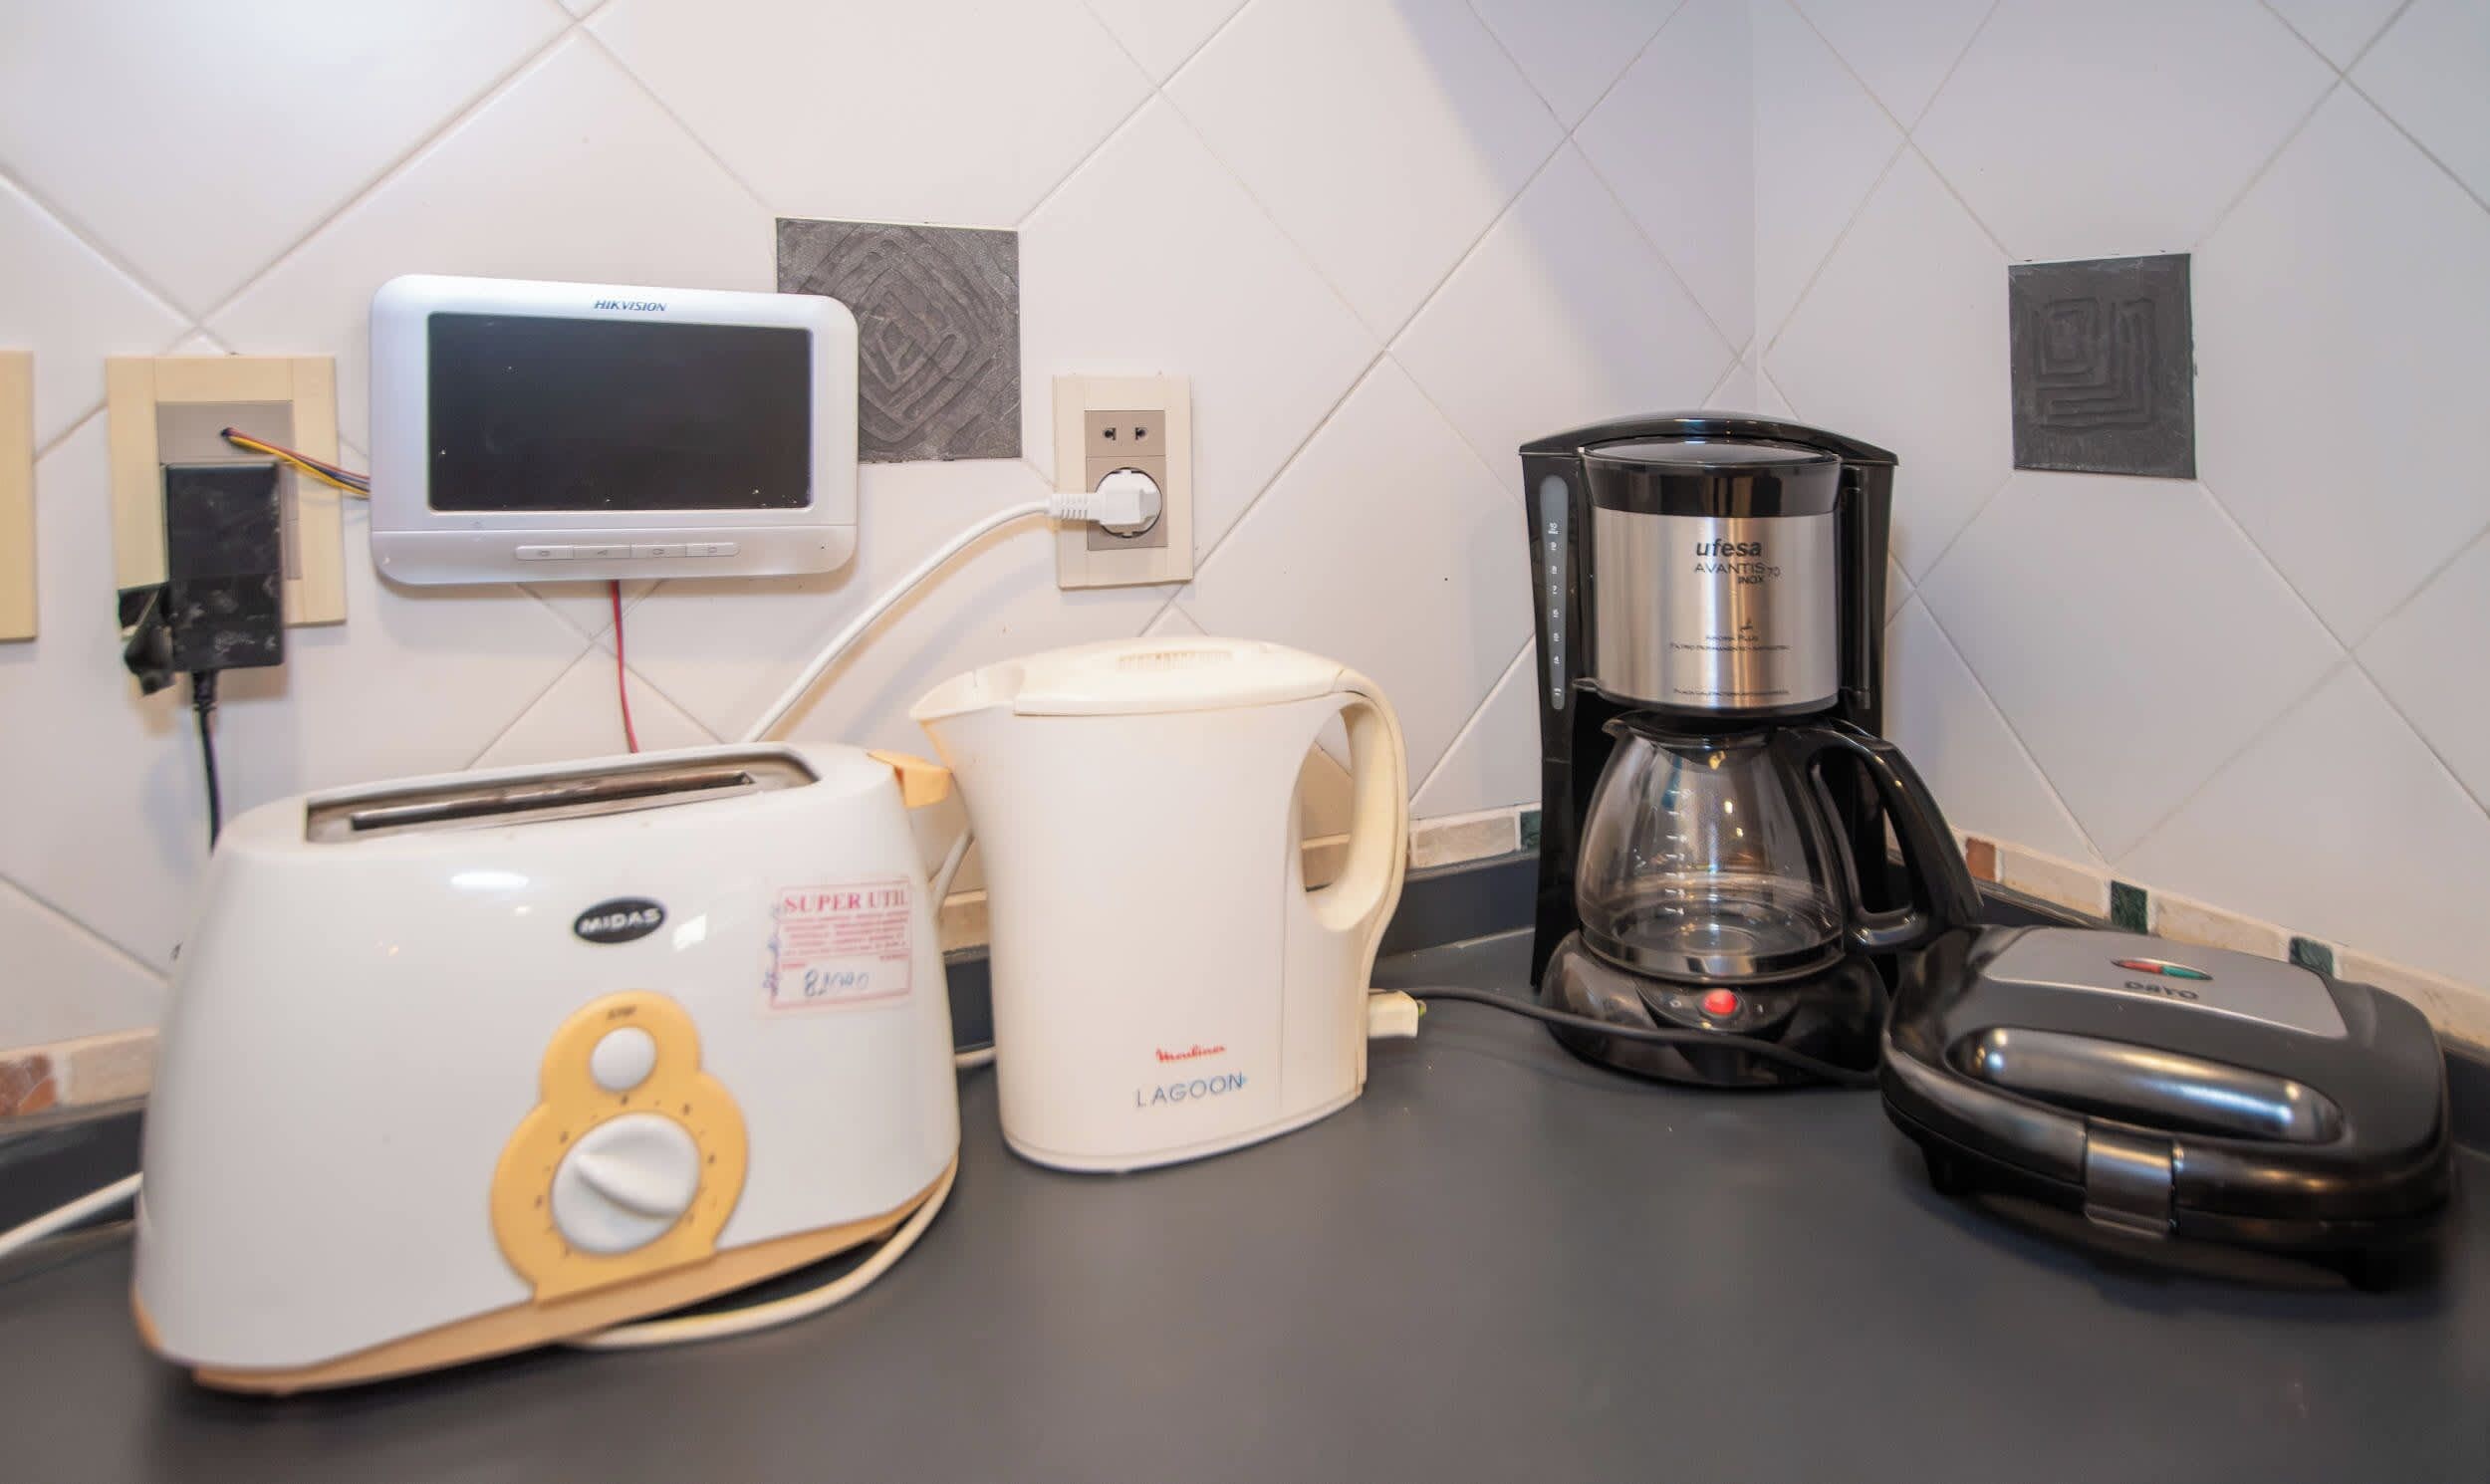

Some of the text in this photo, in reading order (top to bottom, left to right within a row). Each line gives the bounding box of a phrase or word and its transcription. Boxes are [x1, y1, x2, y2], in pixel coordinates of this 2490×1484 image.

[594, 299, 668, 312] HIKVISION
[1695, 538, 1763, 557] ufesa
[1694, 562, 1766, 575] AVANTIS
[783, 892, 861, 912] SUPER
[578, 908, 661, 933] MIDAS
[1136, 1070, 1243, 1109] LAGOON
